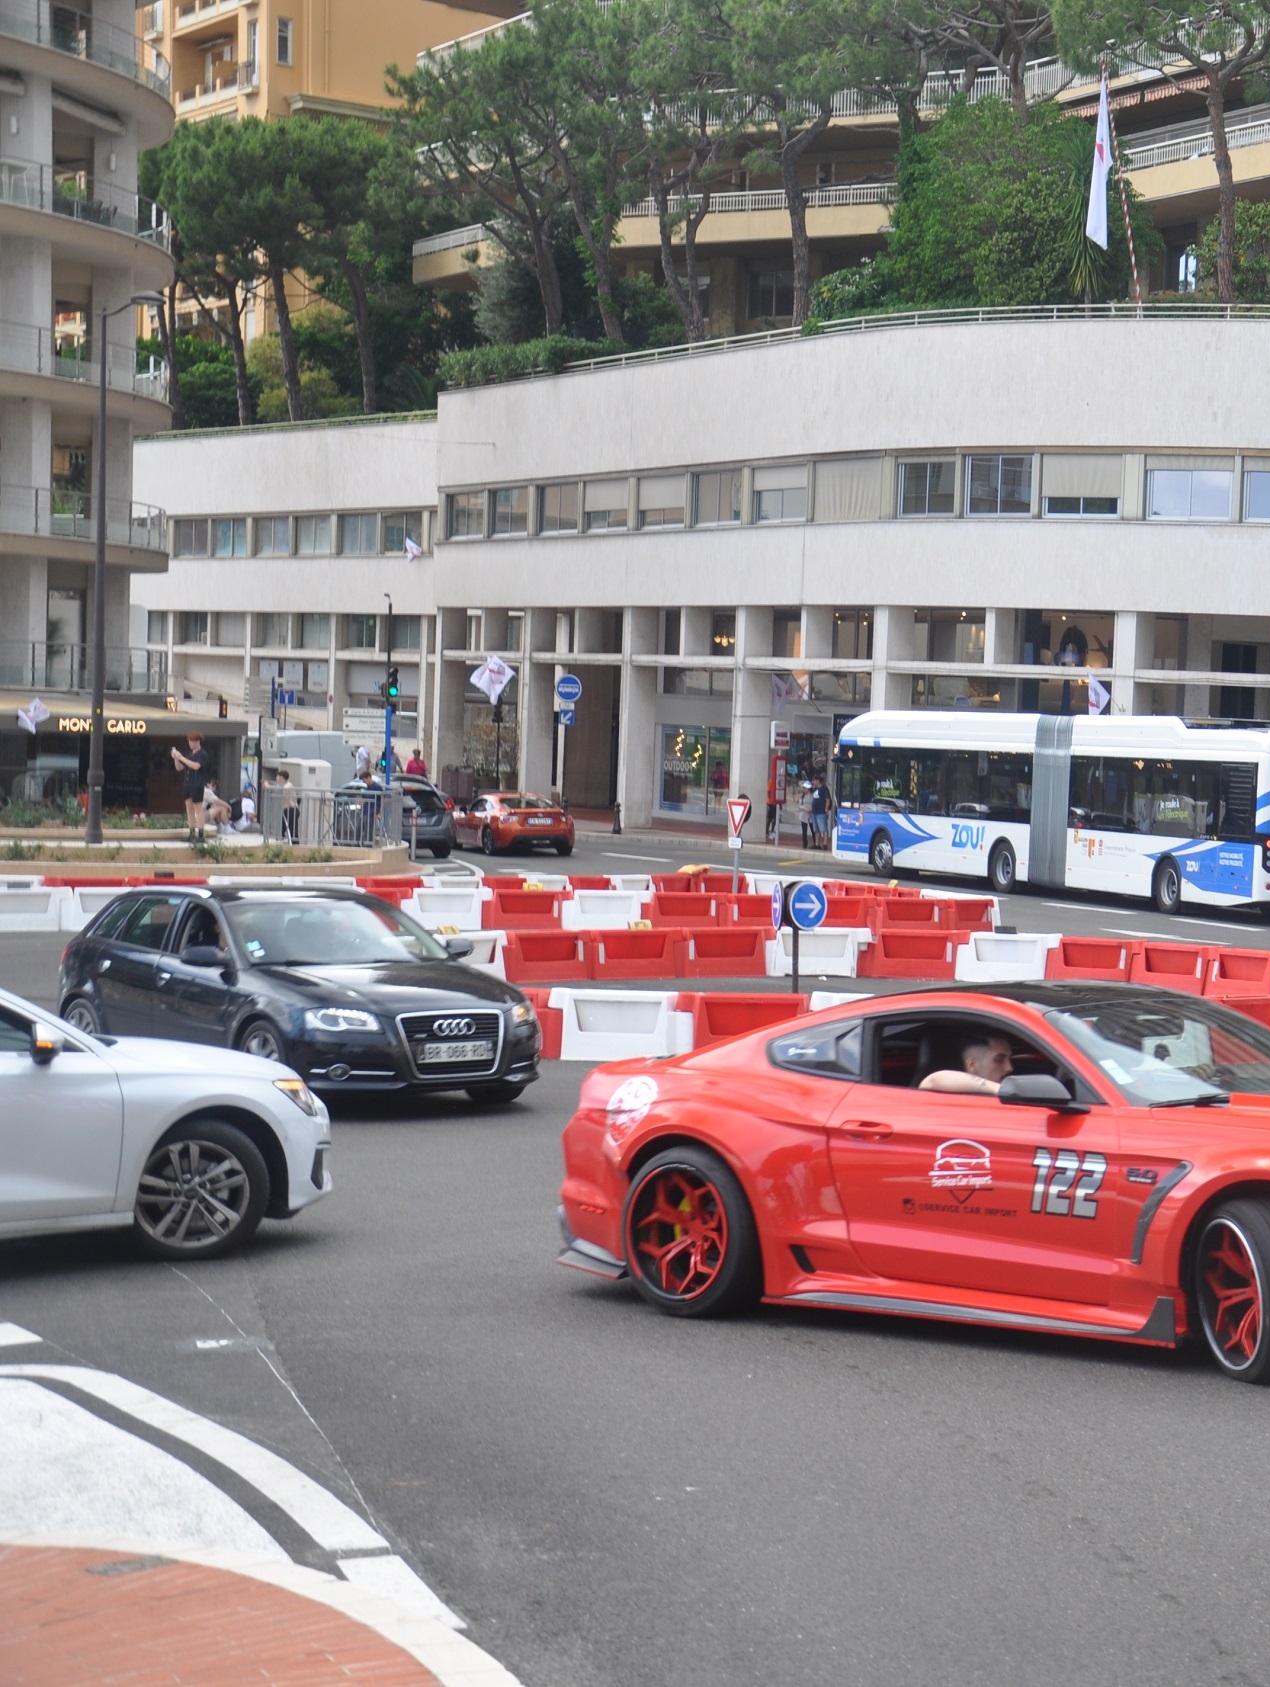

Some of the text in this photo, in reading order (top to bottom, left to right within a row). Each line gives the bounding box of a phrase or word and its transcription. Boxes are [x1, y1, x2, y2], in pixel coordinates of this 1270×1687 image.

[59, 718, 146, 734] MON CARLO
[951, 823, 985, 851] ZOU!
[931, 1176, 958, 1187] Service
[957, 1175, 968, 1186] Car
[1030, 1146, 1108, 1219] 122
